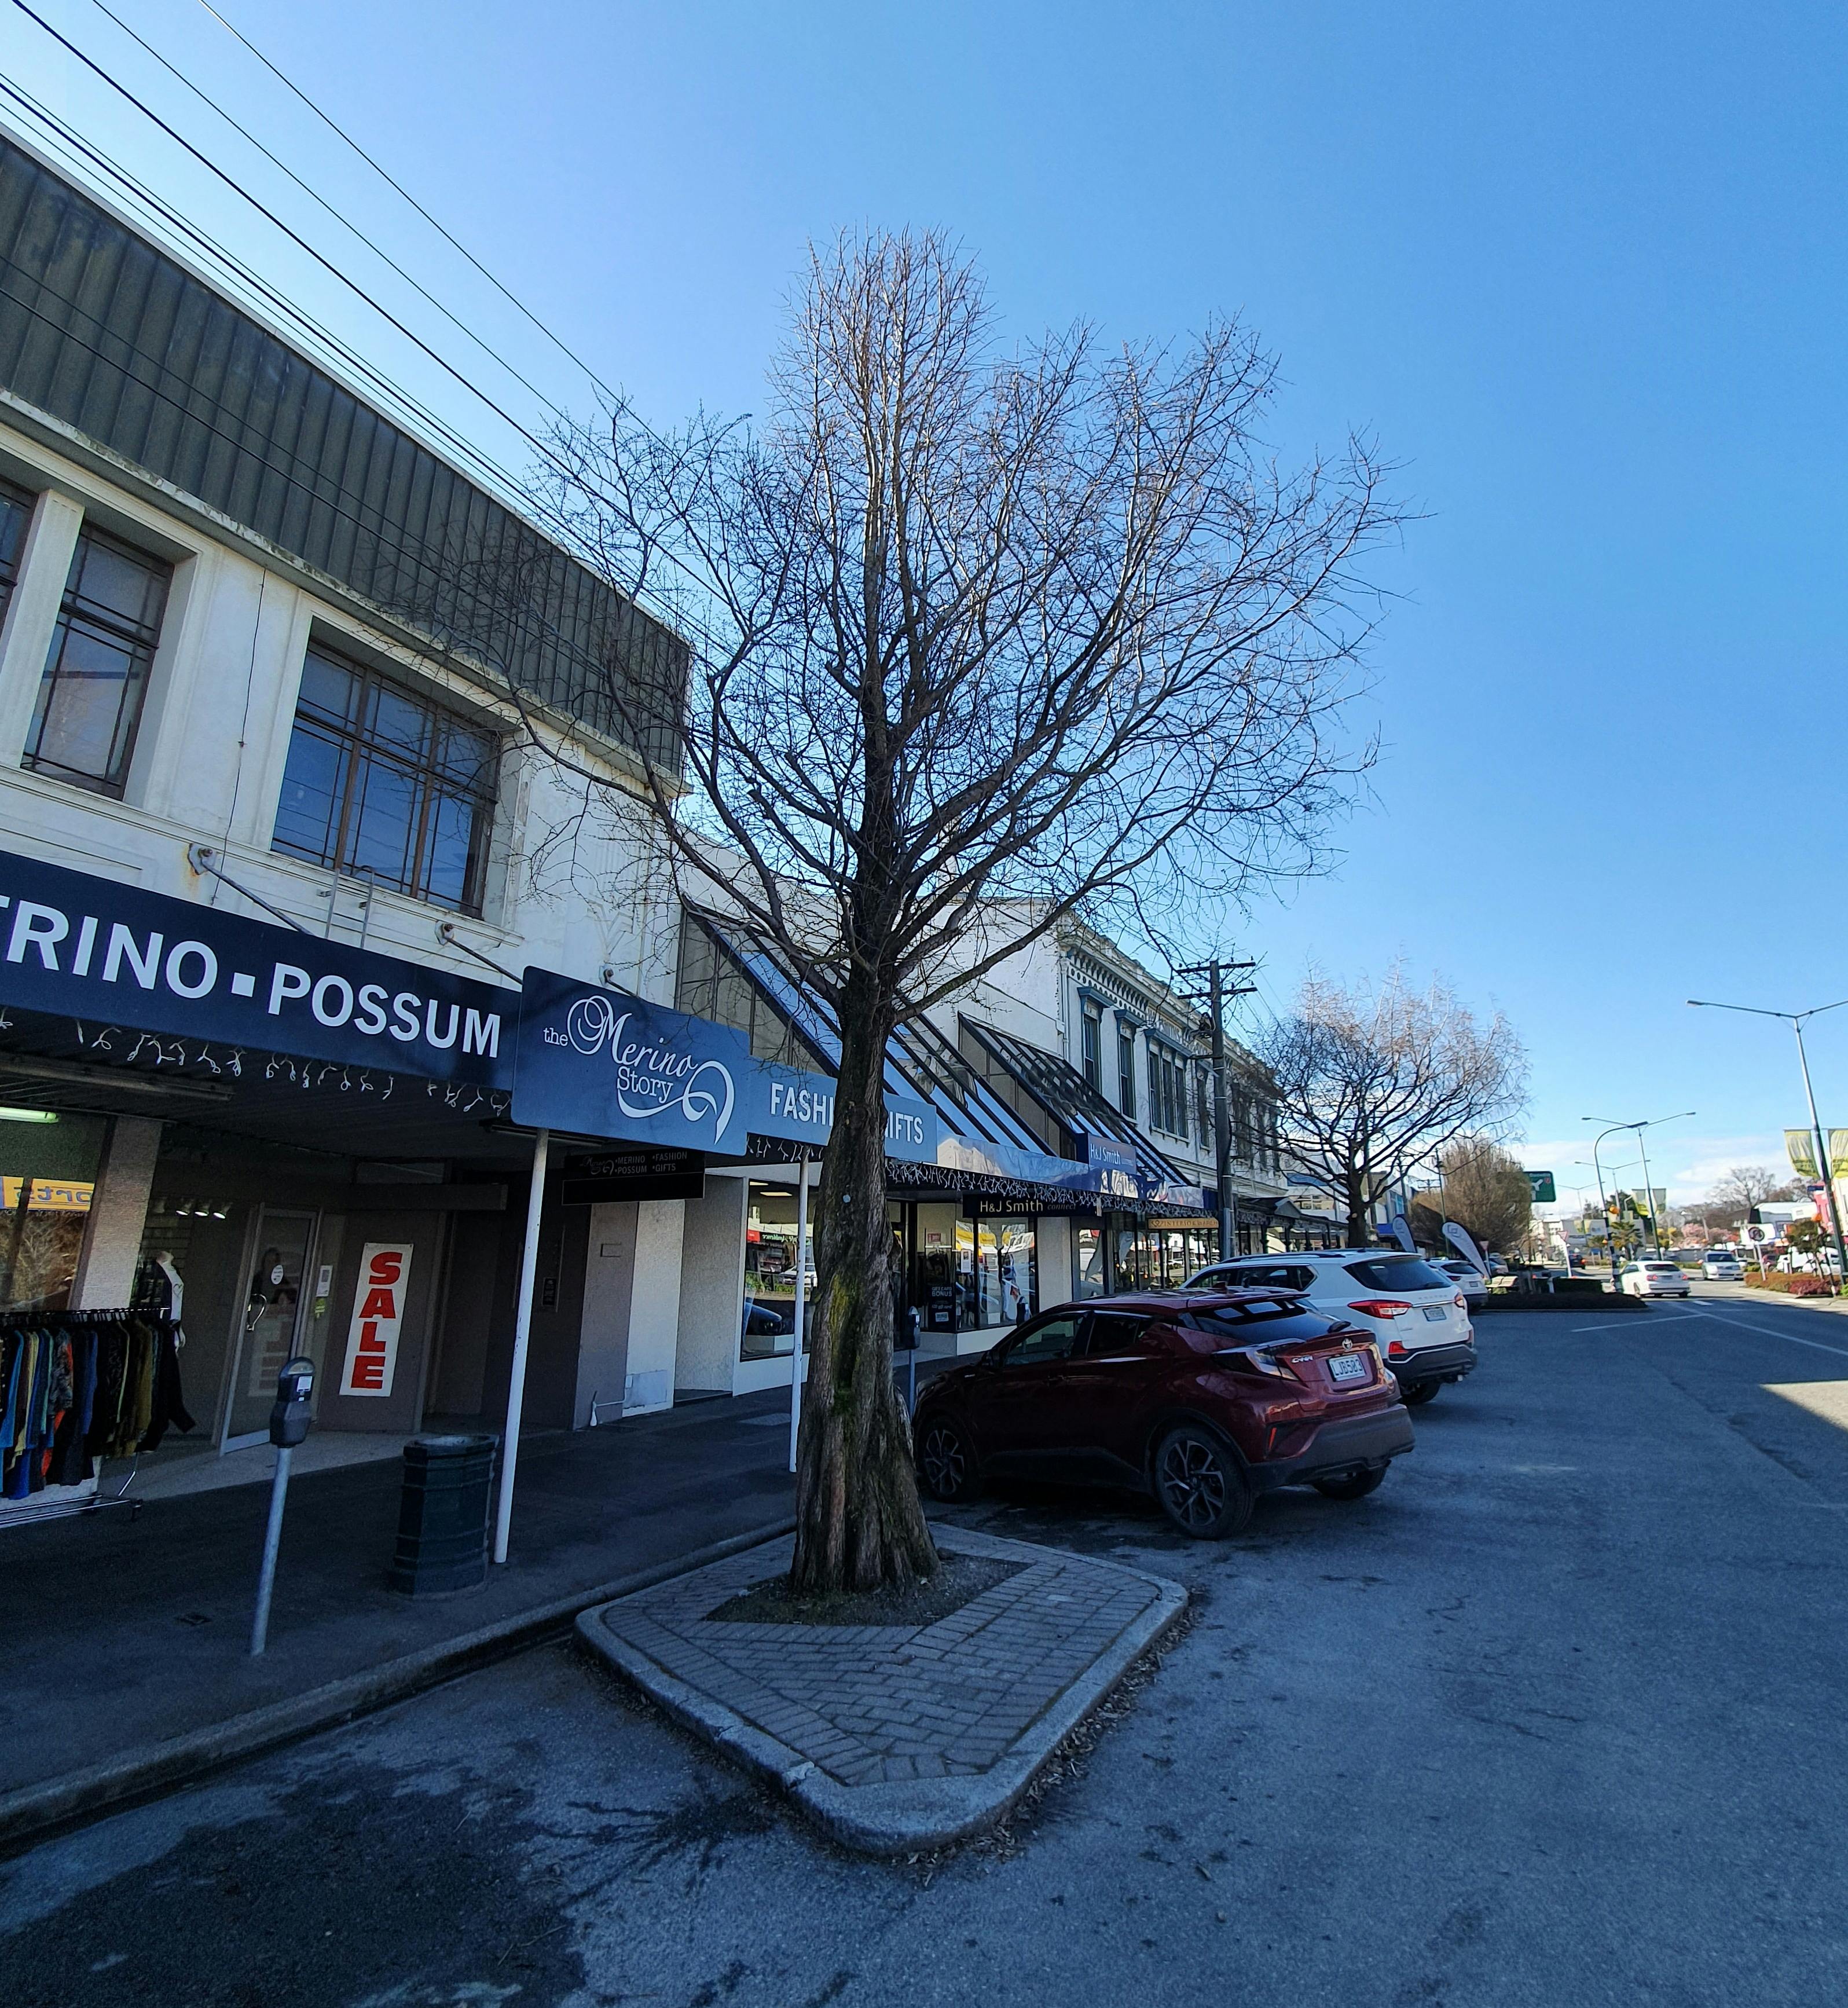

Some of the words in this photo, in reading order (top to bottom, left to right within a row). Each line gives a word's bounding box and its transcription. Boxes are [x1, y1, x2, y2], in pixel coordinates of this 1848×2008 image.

[0, 895, 218, 998] RINO
[267, 962, 500, 1058] POSSUM
[543, 1027, 568, 1046] the
[567, 995, 698, 1077] Merino
[617, 1065, 673, 1104] Story
[771, 1082, 834, 1126] FASHI
[884, 1111, 924, 1144] IFTS
[617, 1155, 645, 1164] MERINO
[655, 1151, 688, 1161] FASHION
[617, 1165, 647, 1174] POSSUM
[655, 1163, 676, 1172] GIFTS
[1090, 1143, 1102, 1160] H&J
[1102, 1147, 1121, 1165] Smith
[980, 1200, 1002, 1212] H&J
[1006, 1199, 1043, 1212] Smith
[351, 1251, 403, 1389] SALE
